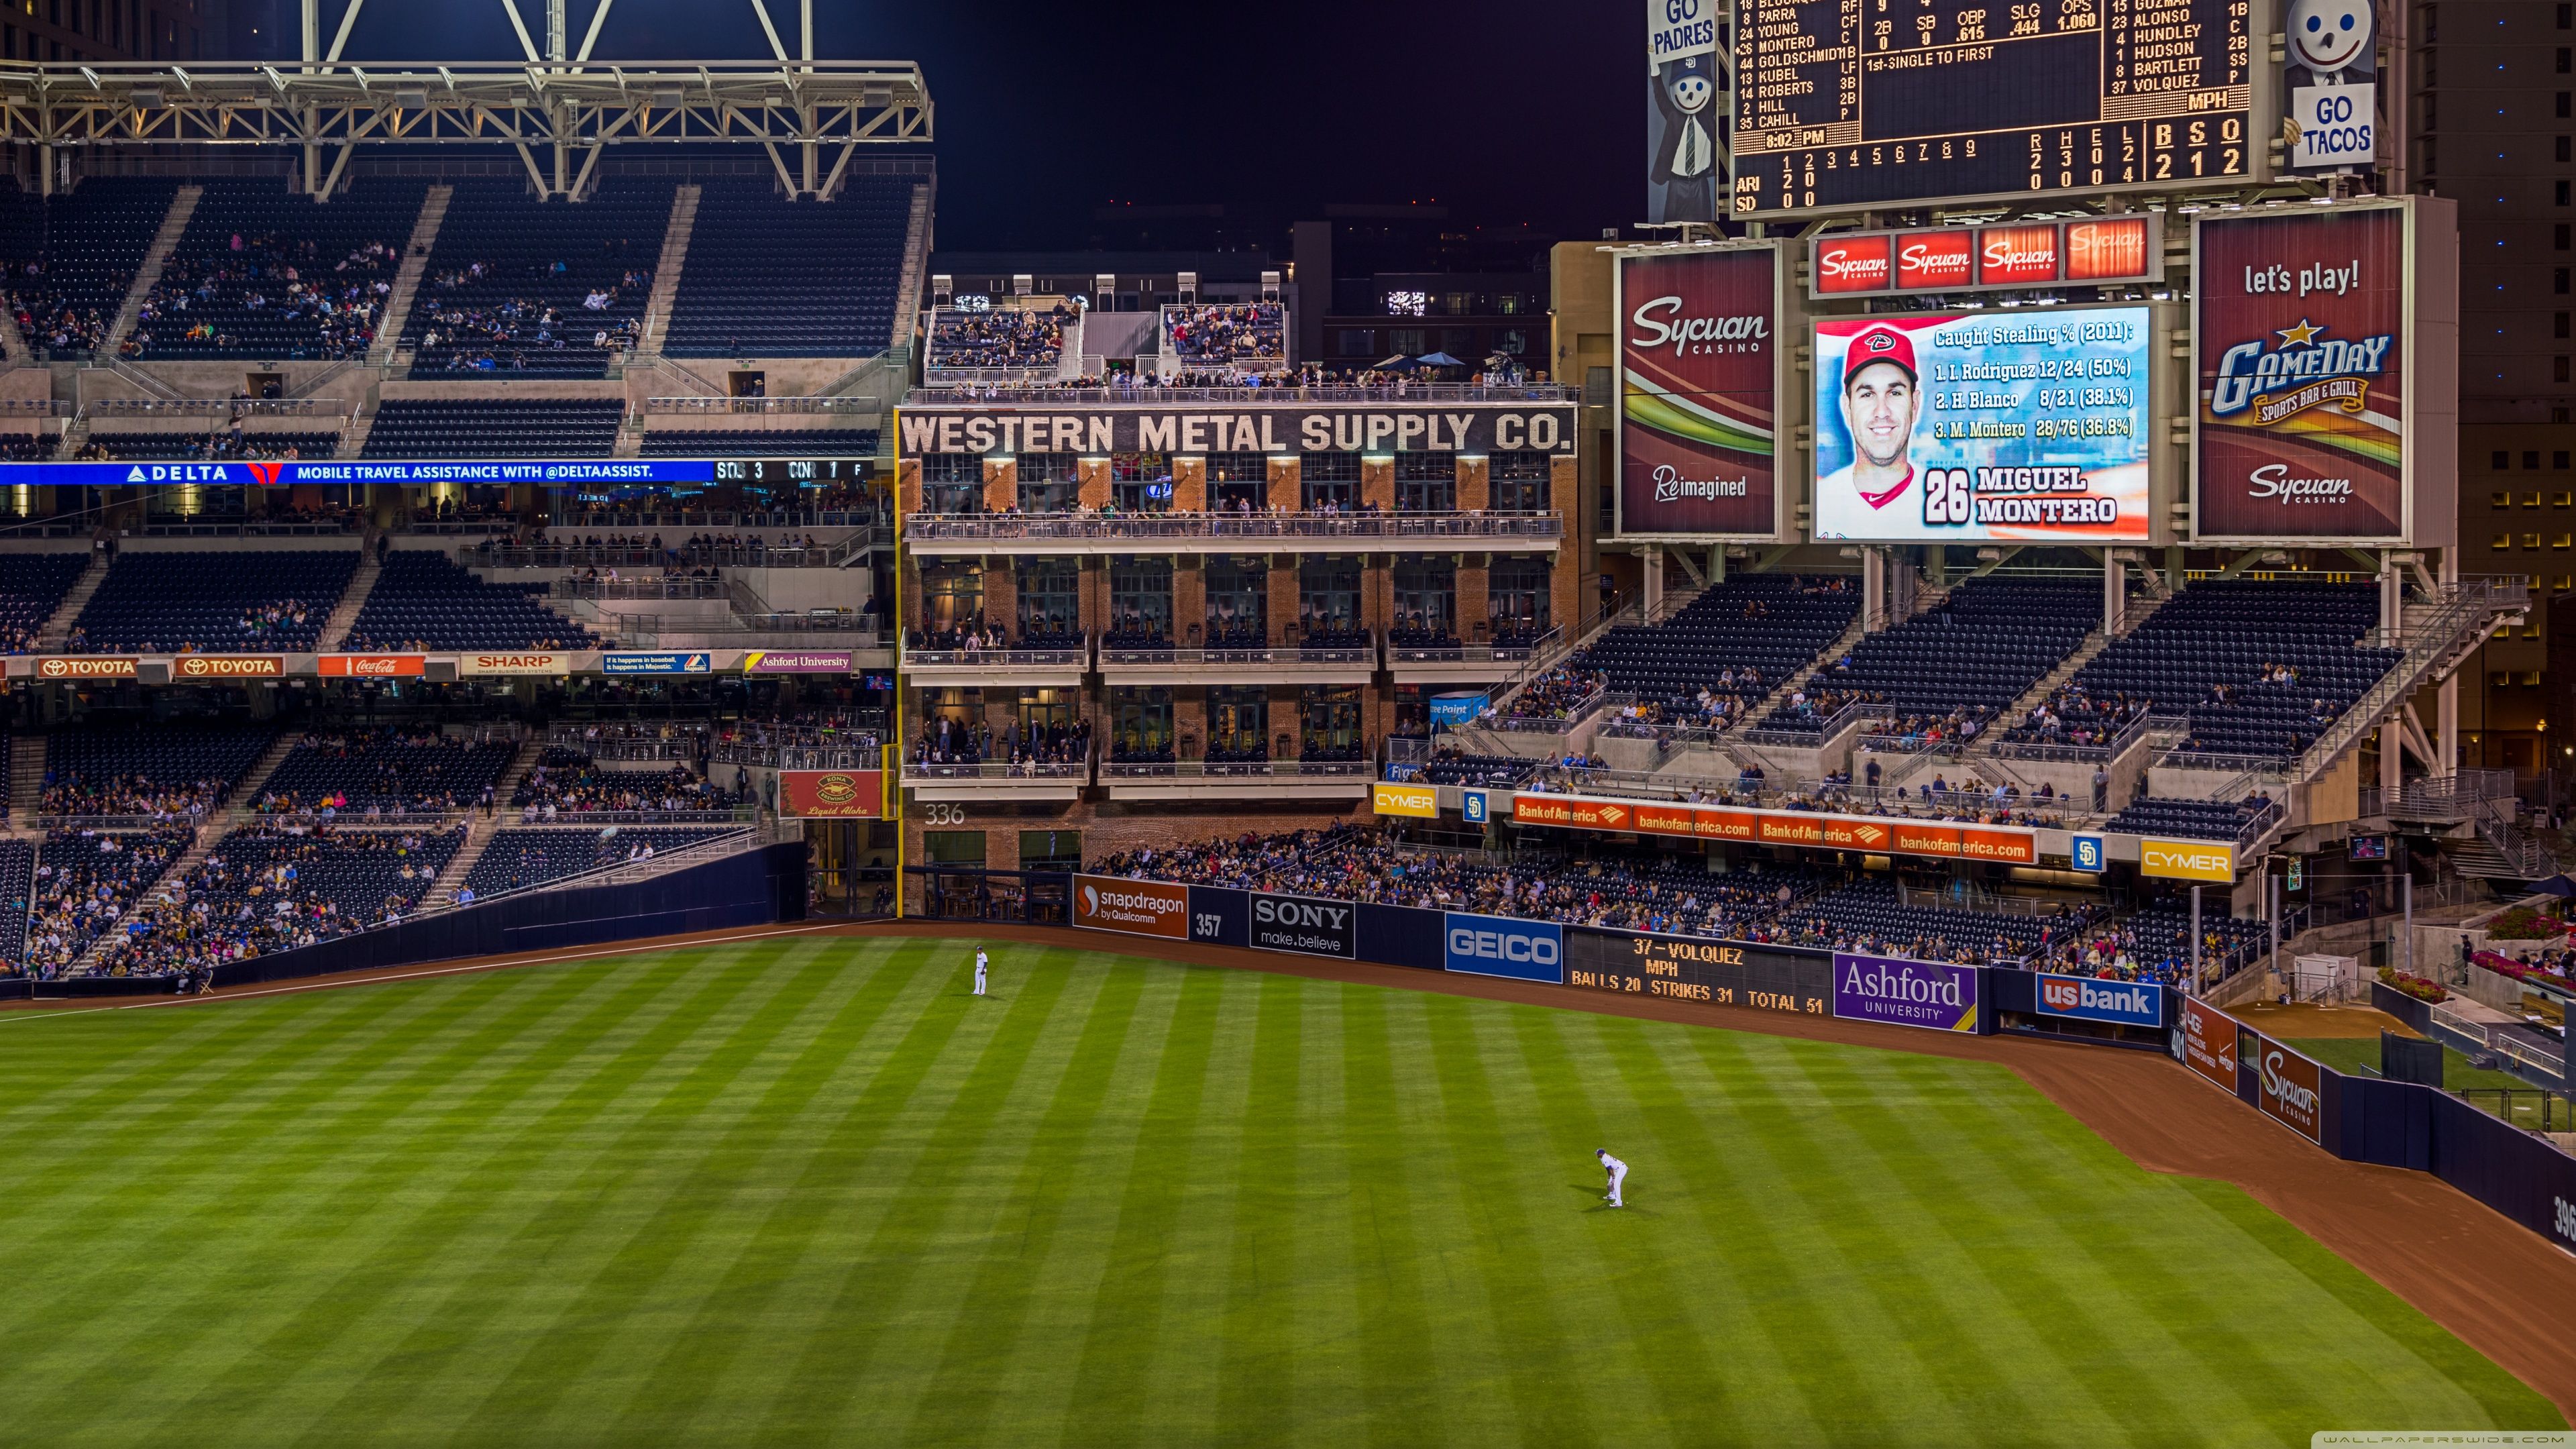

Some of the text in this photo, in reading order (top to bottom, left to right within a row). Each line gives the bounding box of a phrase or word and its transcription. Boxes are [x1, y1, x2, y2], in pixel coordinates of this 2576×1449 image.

[1666, 0, 1698, 24] GO
[1759, 7, 1796, 23] PARRA
[1957, 3, 2041, 25] OBP SLG
[2134, 9, 2190, 27] ALONSO
[1654, 19, 1713, 55] PADRES
[1758, 22, 1799, 38] YOUNG
[1956, 13, 2096, 42] .615 .444 1.060
[2135, 23, 2201, 43] HUNDLEY
[1759, 36, 1815, 53] MONTERO
[2135, 41, 2194, 60] HUDSON
[1759, 48, 1842, 68] GOLDSCHMIDT
[1867, 46, 1994, 71] 1st-SINGLE TO FIRST
[2135, 56, 2202, 76] BARTLETT
[1759, 68, 1799, 83] KUBEL
[2134, 74, 2200, 92] VOLQUEZ
[1759, 81, 1814, 98] ROBERTS
[1759, 99, 1785, 113] HILL
[2188, 91, 2227, 110] MPH
[2316, 96, 2352, 125] GO
[1759, 113, 1800, 128] CAHILL
[1766, 129, 1825, 148] 8:02 PM
[2156, 124, 2171, 146] B
[2190, 121, 2205, 142] S
[2303, 125, 2371, 156] TACOS
[2156, 148, 2239, 178] 2 1 2
[1736, 176, 1760, 193] ARI
[1736, 196, 1756, 211] SD
[2069, 225, 2145, 256] Sycuan
[1821, 250, 1888, 280] Sycuan
[1900, 245, 1970, 275] Sycuan
[1984, 241, 2056, 272] Sycuan
[2245, 259, 2359, 297] let's play!
[1631, 296, 1769, 356] Sycuan
[1935, 322, 2133, 348] Caught Stealing % (2011):
[1693, 343, 1759, 355] CASINO
[1935, 357, 2131, 383] 1. I. Rodriguez 12/24 (50%)
[1935, 386, 2133, 410] 2. H. Blanco 8/21 (38.1%)
[2261, 380, 2358, 422] SPORTS BAR & GRILL
[900, 413, 1570, 453] WESTERN METAL SUPPLY CO.
[1935, 417, 2133, 439] 3. M. Montero 28/76 (36.8%)
[152, 466, 653, 481] DELTA MOBILE TRAVEL ASSISTANCE WITH @DELTAASSIST.
[1653, 464, 1746, 502] Reimagined
[2248, 464, 2353, 504] Sycuan
[1925, 467, 2087, 523] 26 MIGUEL
[1976, 498, 2117, 523] MONTERO
[70, 661, 134, 674] TOYOTA
[210, 660, 274, 673] TOYOTA
[356, 659, 397, 673] Coca-Cola
[478, 656, 552, 667] SHARP
[762, 657, 849, 667] Ashford University
[1442, 704, 1466, 714] Paint
[820, 793, 845, 801] BREWING
[1376, 793, 1434, 810] CYMER
[807, 806, 867, 816] Liquid Aloha
[925, 803, 965, 825] 336
[1519, 804, 1597, 822] Bank of America
[1640, 814, 1750, 835] bankofamerica.com
[1764, 823, 1851, 843] Bank of America
[1900, 835, 2025, 858] bankofamerica.com
[2144, 851, 2229, 871] CYMER
[1101, 892, 1184, 914] snapdragon
[1101, 910, 1156, 924] by Qualcomm
[1256, 900, 1348, 929] SONY
[1196, 914, 1221, 936] 357
[1261, 931, 1340, 951] make.believe
[1450, 928, 1558, 965] GEICO
[1646, 959, 1678, 977] MPH
[1572, 971, 1823, 1014] BALLS 20 STRIKES 31 TOTAL 51
[1842, 961, 1962, 1006] Ashford
[1866, 1001, 1941, 1020] UNIVERSITY
[2171, 1029, 2185, 1061] 401
[2218, 1053, 2234, 1072] verizon
[2265, 1051, 2314, 1114] Sycuan
[2286, 1106, 2310, 1126] CASINO
[2554, 1196, 2576, 1242] 396
